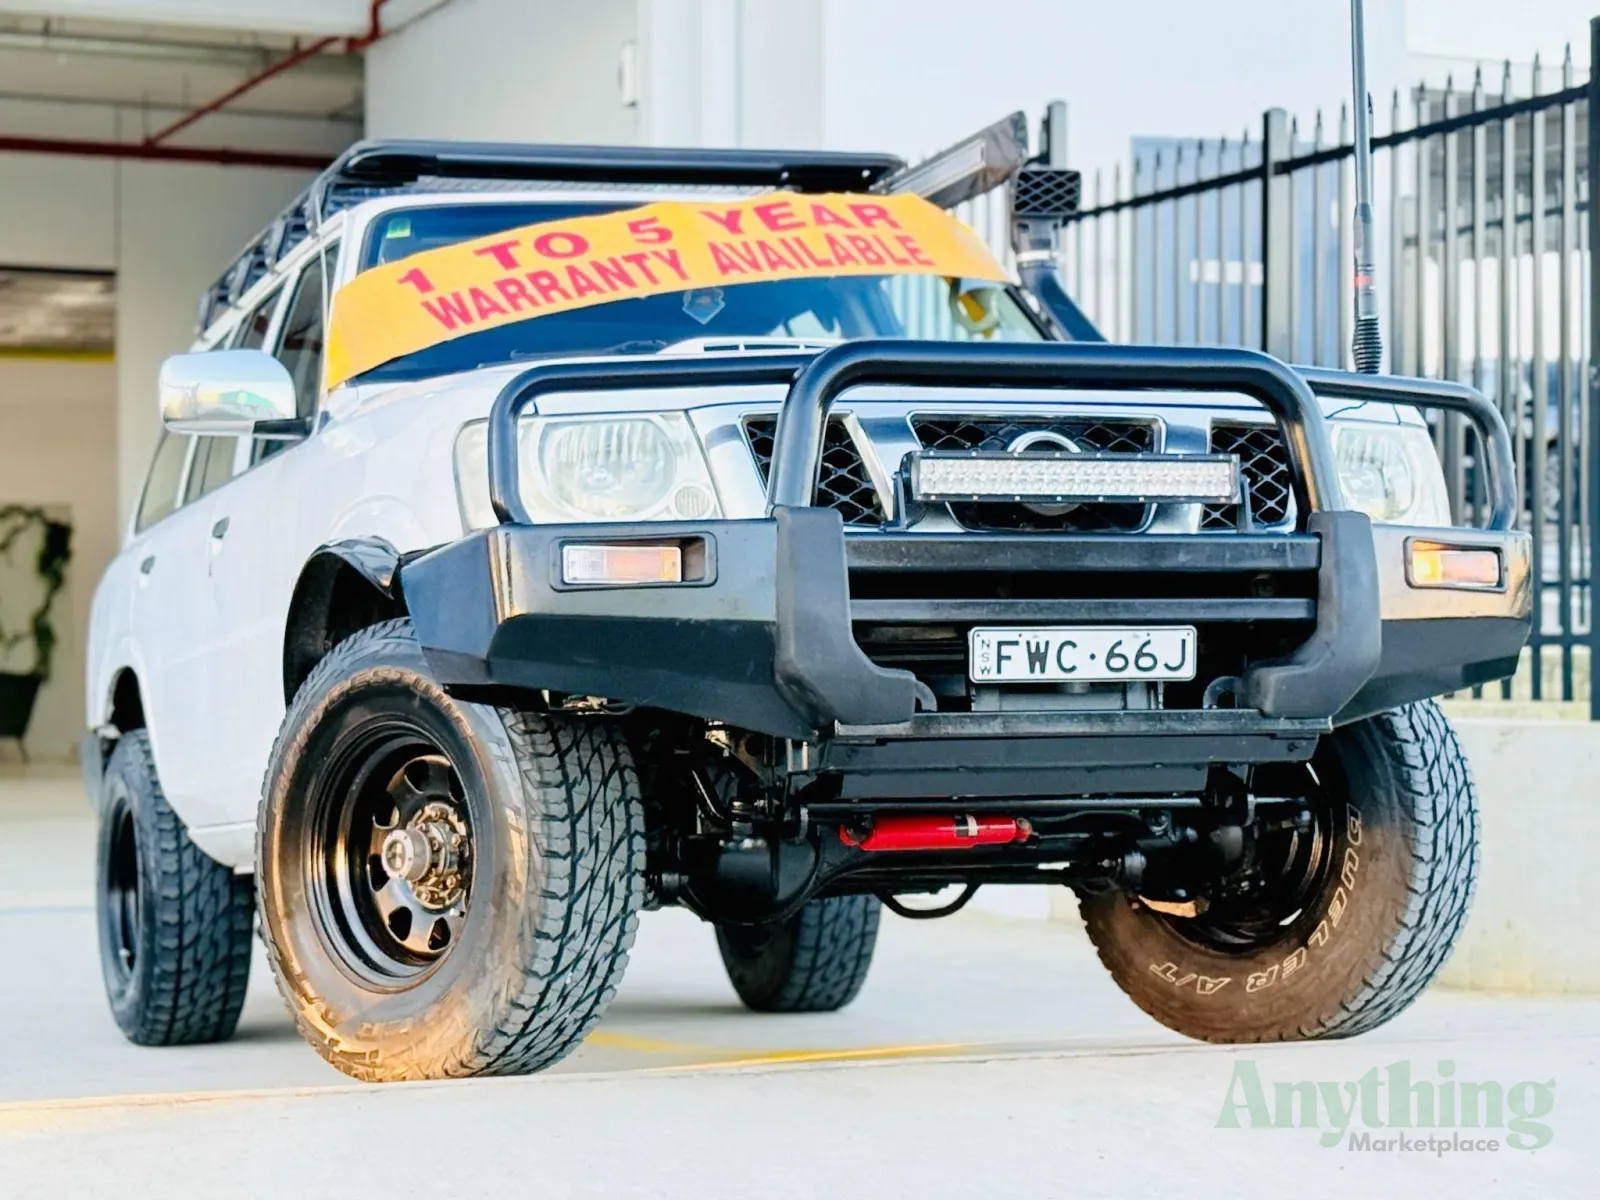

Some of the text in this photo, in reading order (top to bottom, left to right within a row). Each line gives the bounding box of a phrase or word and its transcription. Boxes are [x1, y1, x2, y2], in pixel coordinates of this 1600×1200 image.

[398, 201, 900, 294] 1 TO 5 YEAR
[420, 233, 935, 330] WARRANTY AVAILABLE
[1150, 803, 1363, 995] DUELER A/T
